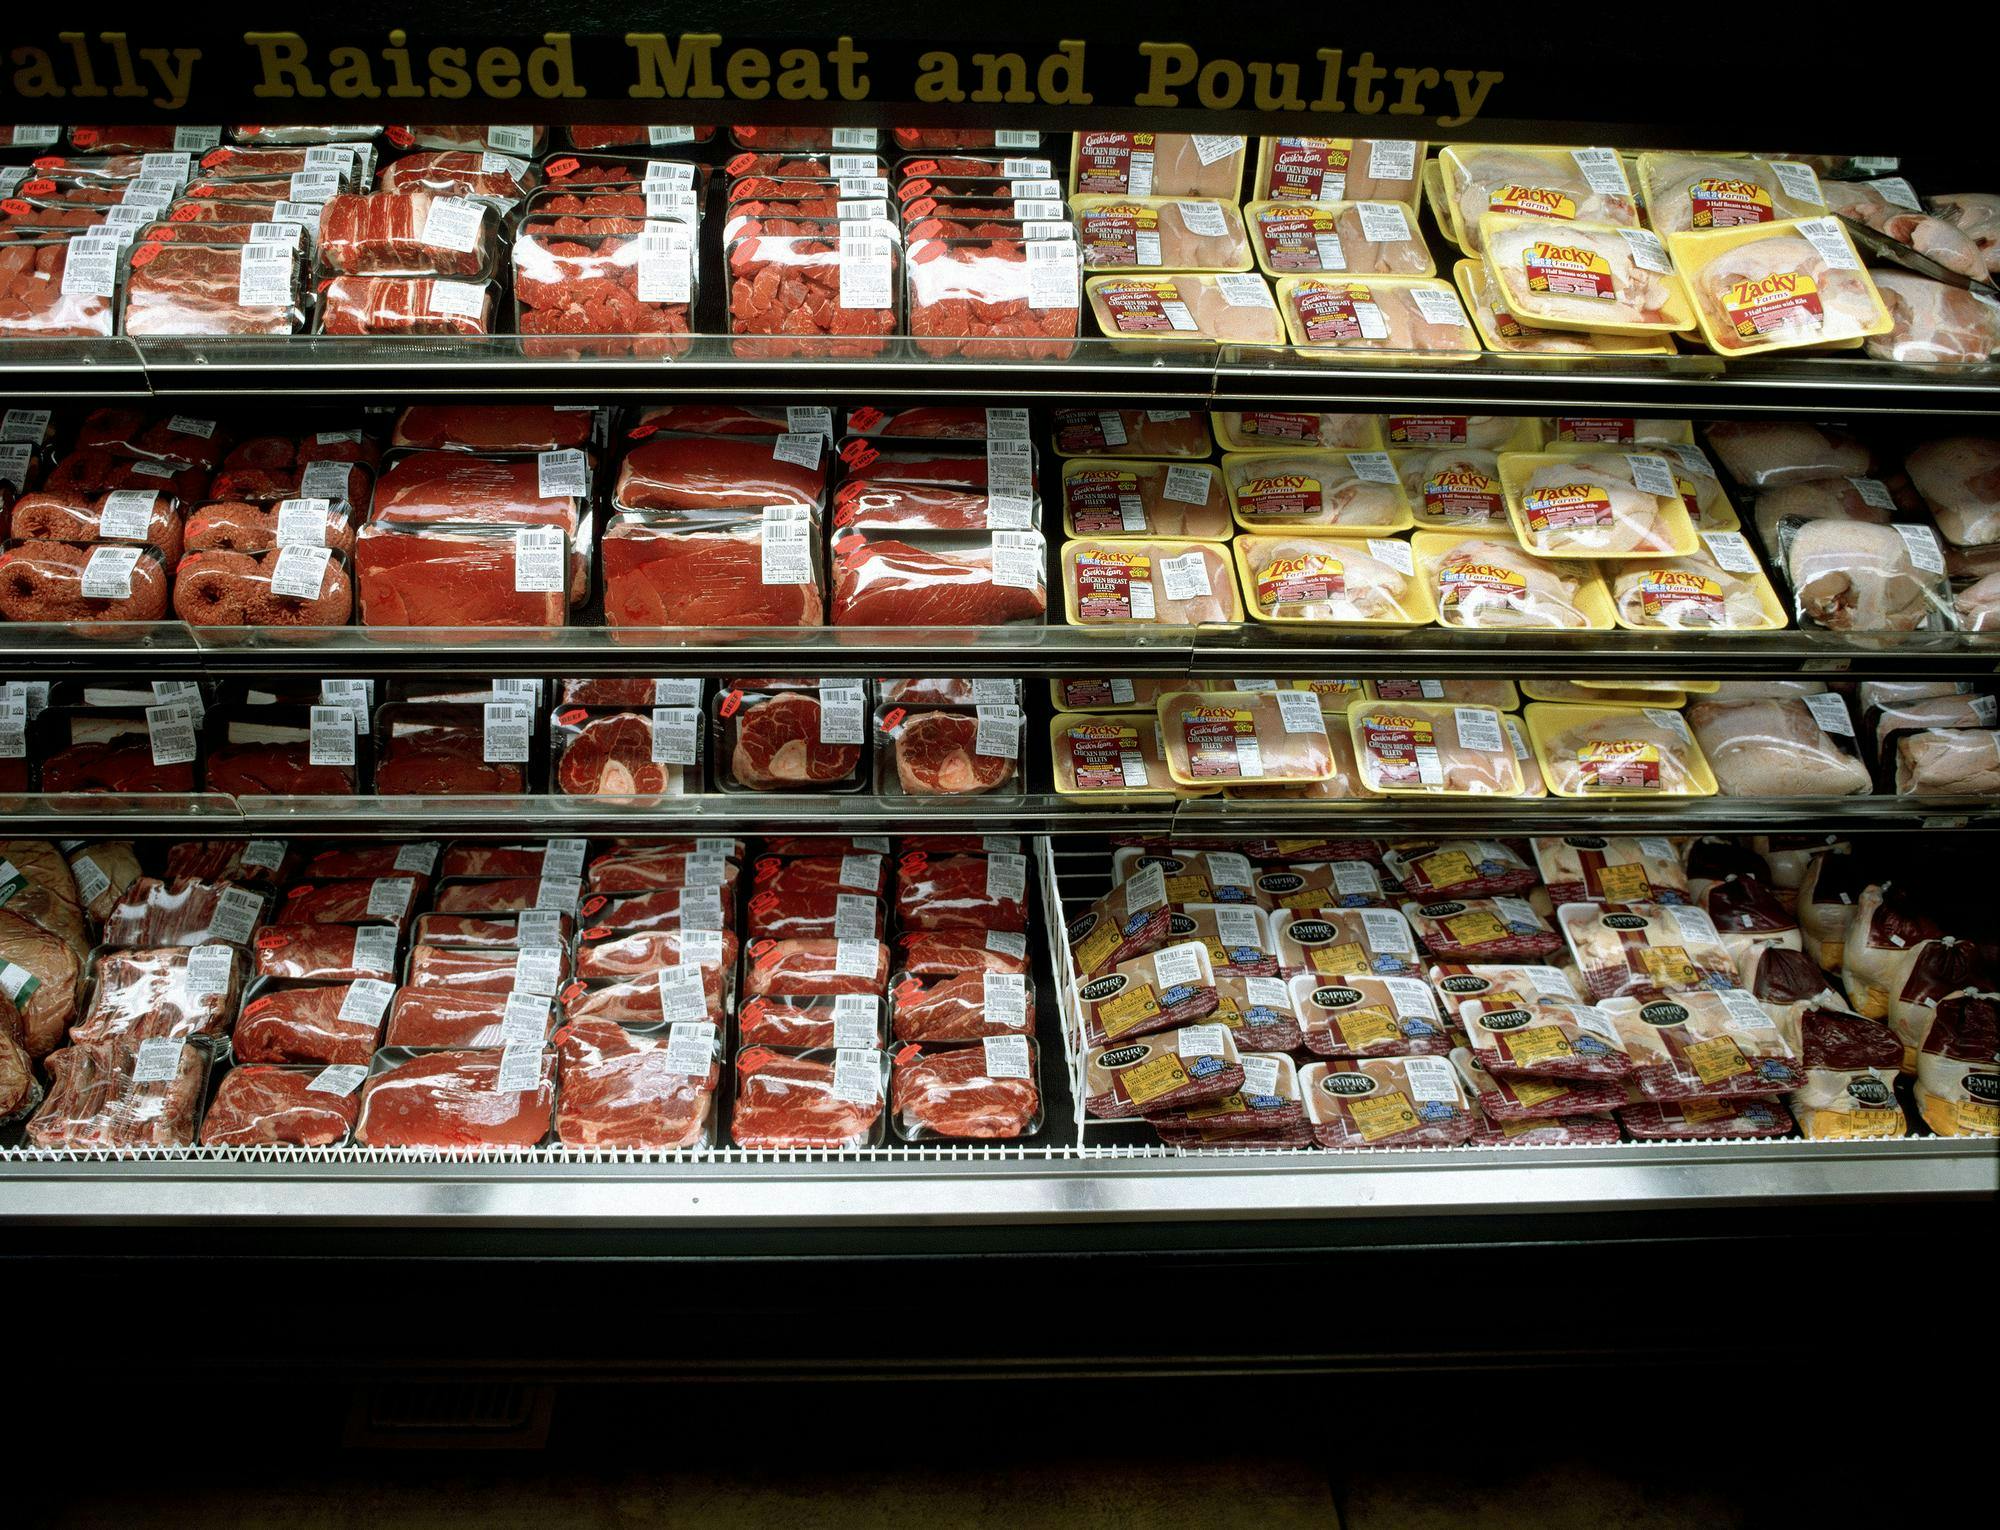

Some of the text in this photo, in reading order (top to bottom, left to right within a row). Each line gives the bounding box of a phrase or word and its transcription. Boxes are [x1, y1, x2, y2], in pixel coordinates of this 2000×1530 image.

[245, 28, 586, 98] Raised
[625, 32, 870, 100] Meat
[915, 39, 1093, 105] and
[1135, 41, 1504, 127] Poultry
[1082, 147, 1129, 156] CHICKEN BREAST
[551, 162, 574, 174] BEEF
[731, 157, 751, 171] BEEF
[909, 164, 930, 174] BEEF
[1274, 165, 1322, 176] CHICKEN BREAST
[1286, 174, 1308, 184] FILLETS
[903, 182, 925, 196] BEEF
[1703, 179, 1759, 198] Zacky
[1505, 186, 1564, 208] Zacky
[1721, 193, 1749, 201] Farms
[6, 202, 25, 212] VEAL
[908, 202, 930, 218] BEEF
[1097, 206, 1141, 215] Zacky
[1520, 201, 1550, 211] Farms
[1537, 244, 1596, 266] Zacky
[1734, 272, 1797, 304] Zacky
[1757, 292, 1789, 304] Farms
[1300, 302, 1329, 312] CHICKEN
[1316, 306, 1339, 314] FILLETS
[1250, 475, 1308, 493] Zacky
[1434, 472, 1489, 489] Zacky
[1535, 484, 1592, 501] Zacky
[1090, 549, 1134, 563] Zacky
[1456, 564, 1510, 579] Zacky
[1093, 583, 1115, 591] FILLETS
[1194, 706, 1237, 718] Zacky
[1375, 715, 1416, 728] Zacky
[1082, 725, 1122, 735] Zacky
[1213, 735, 1233, 743] BREAST
[1369, 742, 1393, 750] CHICKEN
[1086, 755, 1108, 763] FILLETS
[1262, 876, 1300, 885] EMPIRE
[1070, 917, 1094, 934] MPIRE
[1172, 917, 1192, 926] PIRE
[1293, 925, 1330, 934] EMPIRE
[1084, 976, 1122, 993] EMPIRE
[1443, 978, 1483, 988] EMPIRE
[1085, 985, 1125, 998] KOSHER
[1316, 991, 1356, 1001] EMPIRE
[1642, 1005, 1684, 1018] EMPIRE
[1483, 1012, 1525, 1023] EMPIRE
[1103, 1047, 1145, 1061] EMPIRE
[1104, 1054, 1145, 1066] KOSHER
[1328, 1078, 1369, 1088] EMPIRE
[1850, 1083, 1884, 1094] EMPIRE
